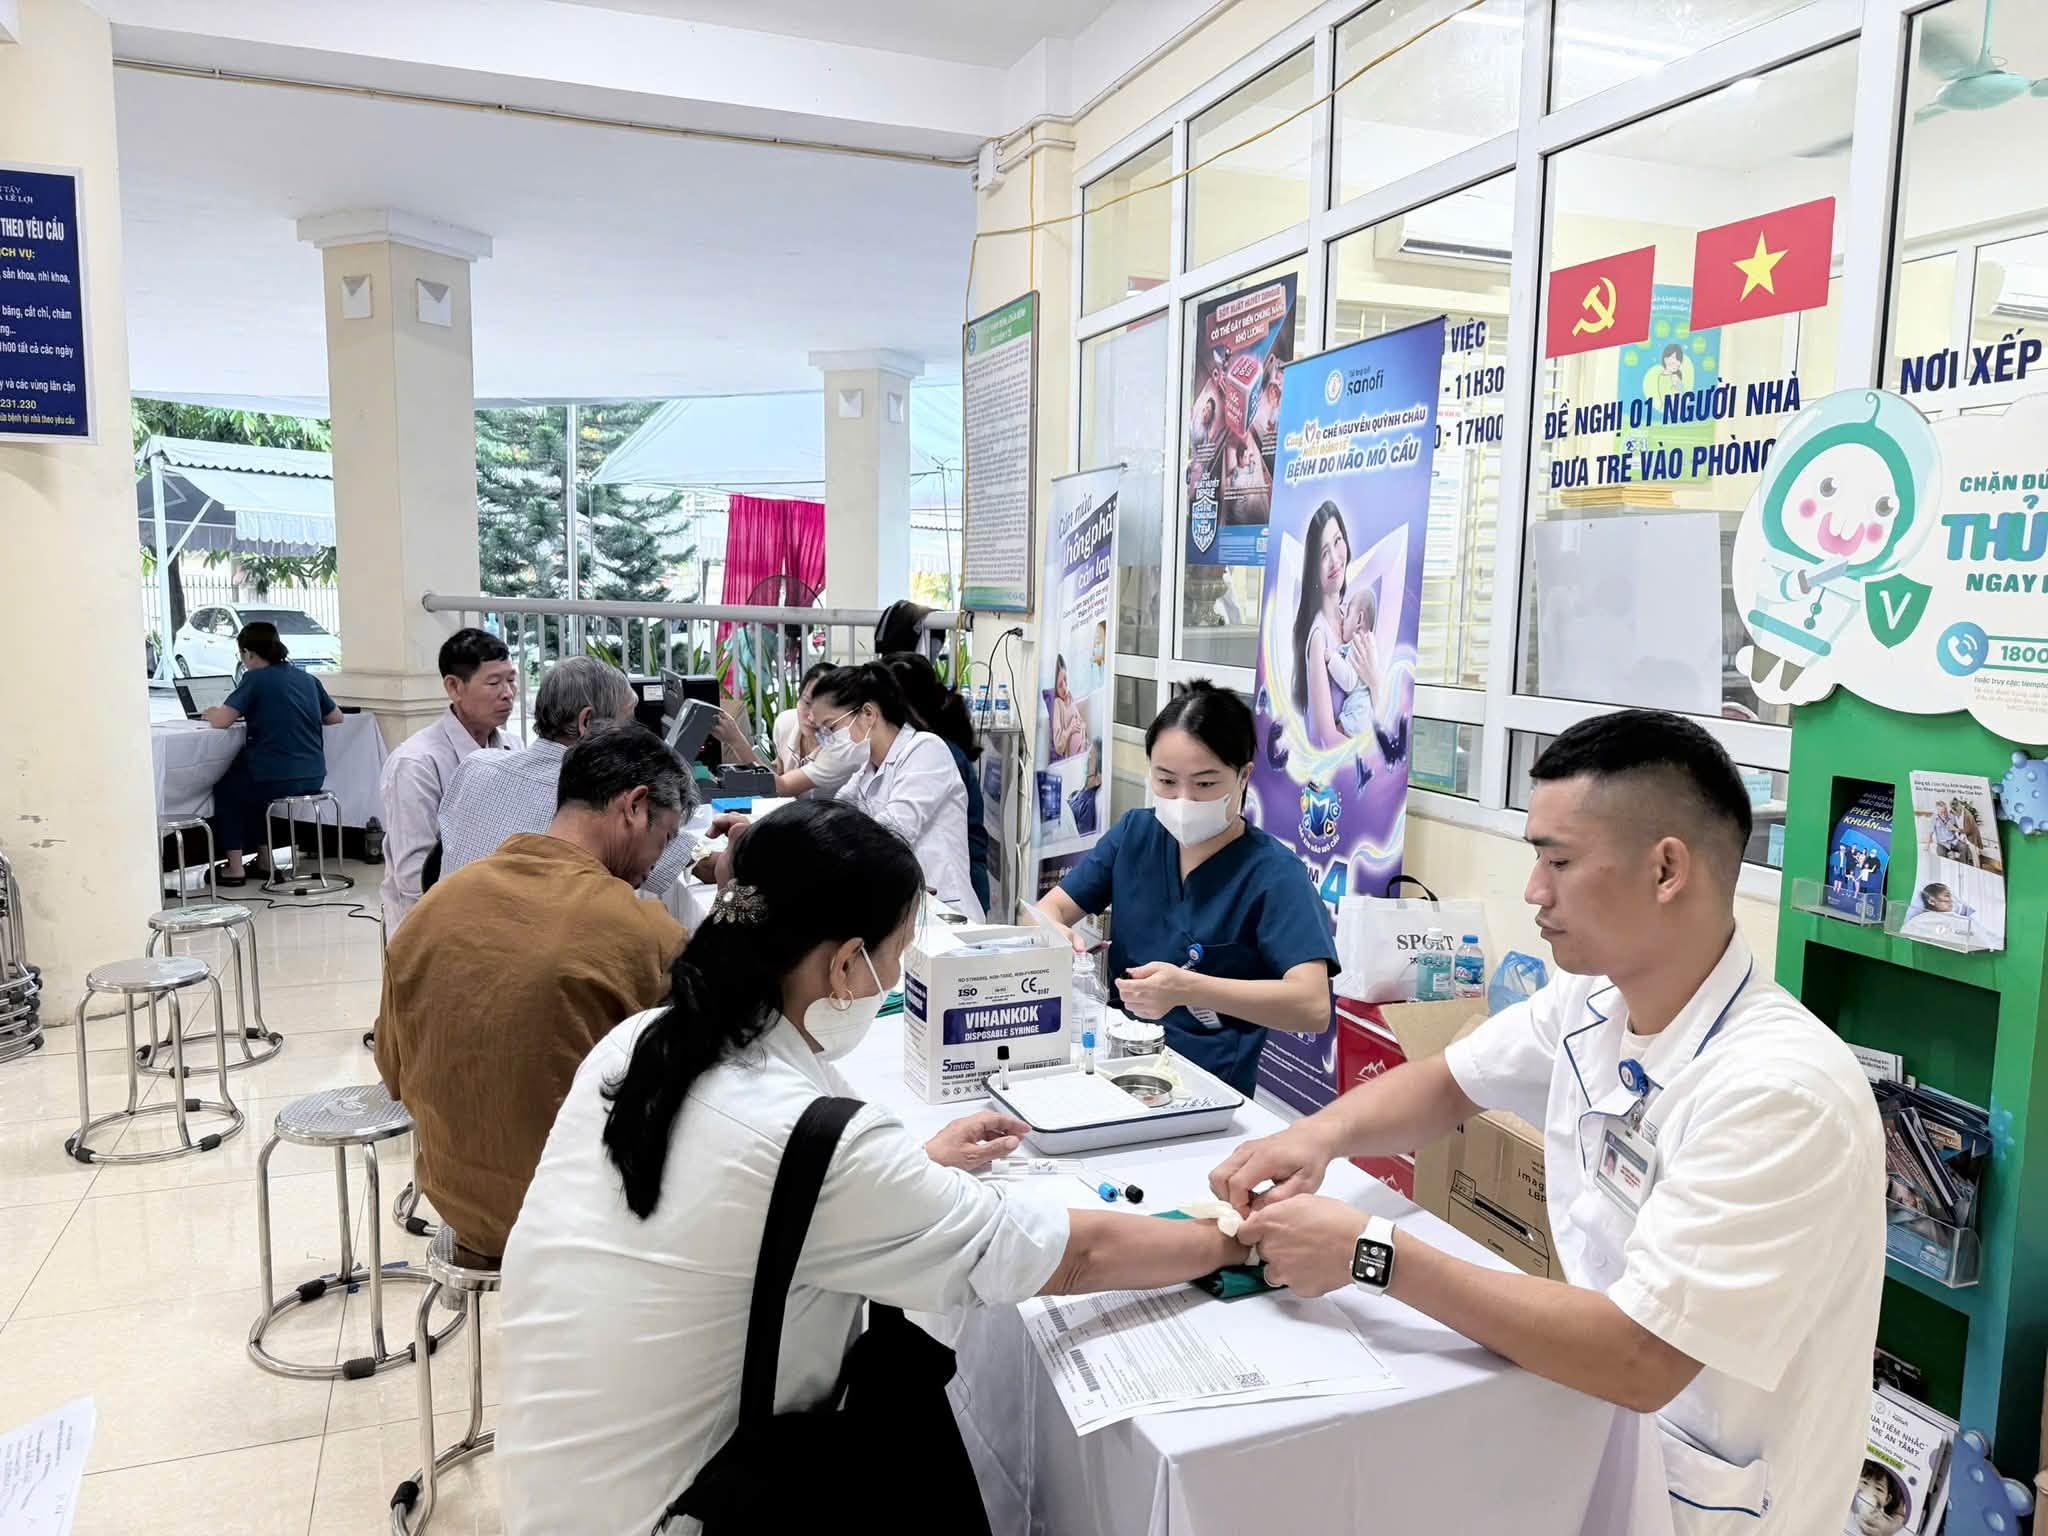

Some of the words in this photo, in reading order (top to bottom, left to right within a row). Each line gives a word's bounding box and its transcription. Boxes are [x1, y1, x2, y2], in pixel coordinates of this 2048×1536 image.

[0, 217, 24, 238] THEO
[25, 216, 43, 239] YÊU
[17, 269, 37, 282] khoa,
[1451, 317, 1486, 356] VIỆC
[41, 344, 53, 354] các
[56, 344, 73, 358] ngày
[1900, 348, 1959, 395] NƠI
[1968, 328, 2042, 386] XẾP
[1347, 369, 1384, 395] sanofi
[1456, 366, 1505, 400] 11H30
[1544, 399, 1570, 440] ĐỀ
[1575, 401, 1623, 437] NGHỊ
[1630, 397, 1653, 428] 01
[1663, 377, 1737, 425] NGƯỜI
[1746, 370, 1801, 417] NHÀ
[1372, 413, 1401, 432] QUỲNH
[1456, 414, 1504, 446] 17H00
[1287, 456, 1317, 482] BỆNH
[1319, 455, 1336, 474] DO
[1336, 448, 1364, 472] NÃO
[1366, 443, 1388, 468] MÔ
[1390, 436, 1419, 463] CẦU
[1551, 456, 1589, 489] ĐƯA
[1641, 441, 1683, 481] VÀO
[1960, 471, 2018, 494] CHẶN
[1966, 573, 2037, 593] NGAY
[2001, 645, 2048, 664] 1800
[958, 988, 978, 997] ISO
[1021, 977, 1037, 993] CE
[965, 1005, 1040, 1029] VIHANKOK
[965, 1028, 1008, 1041] DISPOSABLE
[1010, 1025, 1040, 1036] SYRINGE
[1882, 1421, 1900, 1436] TIÊM
[1884, 1434, 1896, 1444] AN
